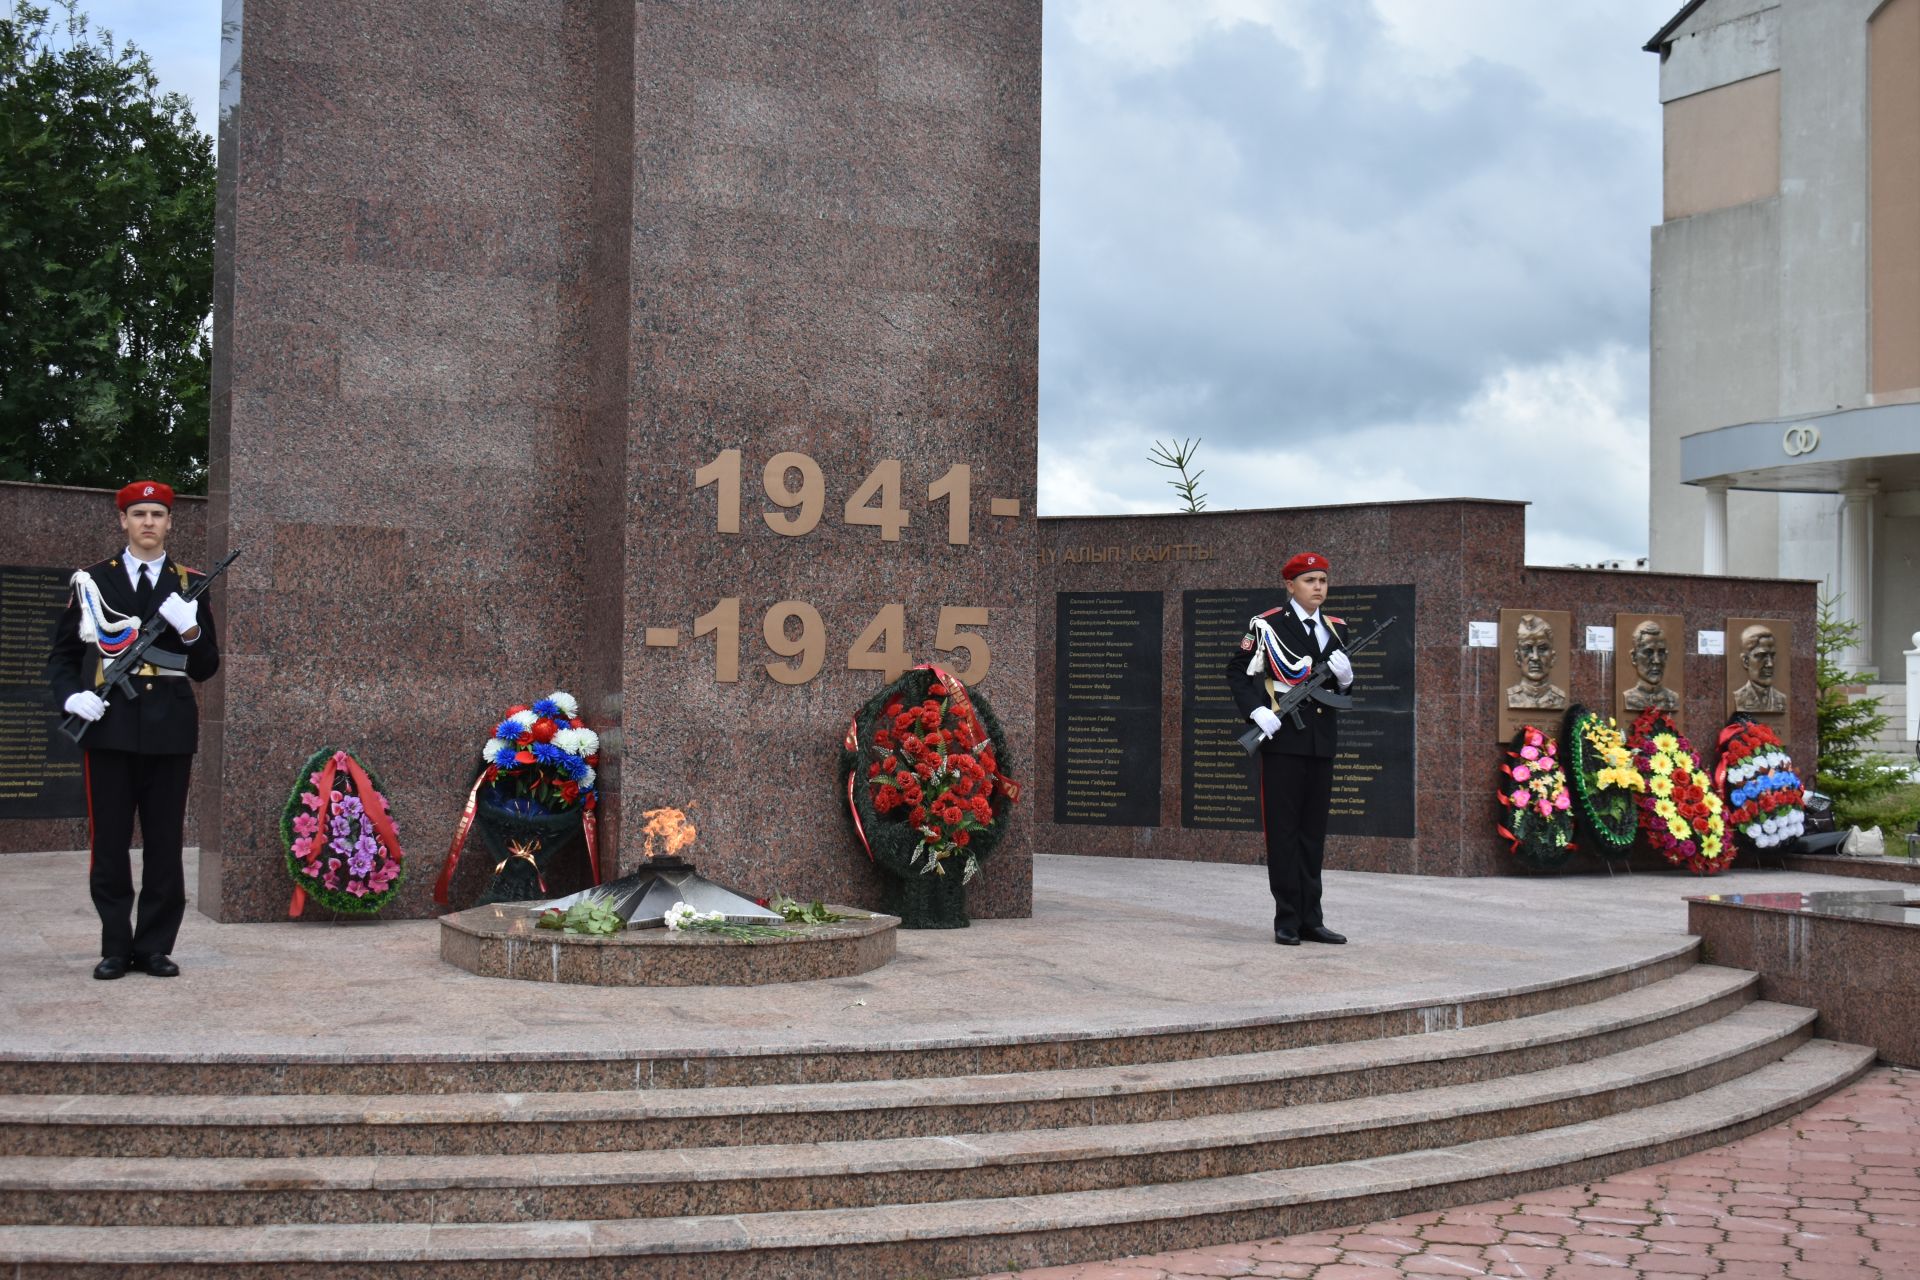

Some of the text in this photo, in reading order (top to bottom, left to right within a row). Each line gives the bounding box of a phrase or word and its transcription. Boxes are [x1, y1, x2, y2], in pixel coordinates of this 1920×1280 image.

[695, 449, 1020, 545] 1941-
[1063, 546, 1122, 563] АЛЫП
[645, 598, 991, 687] -1945
